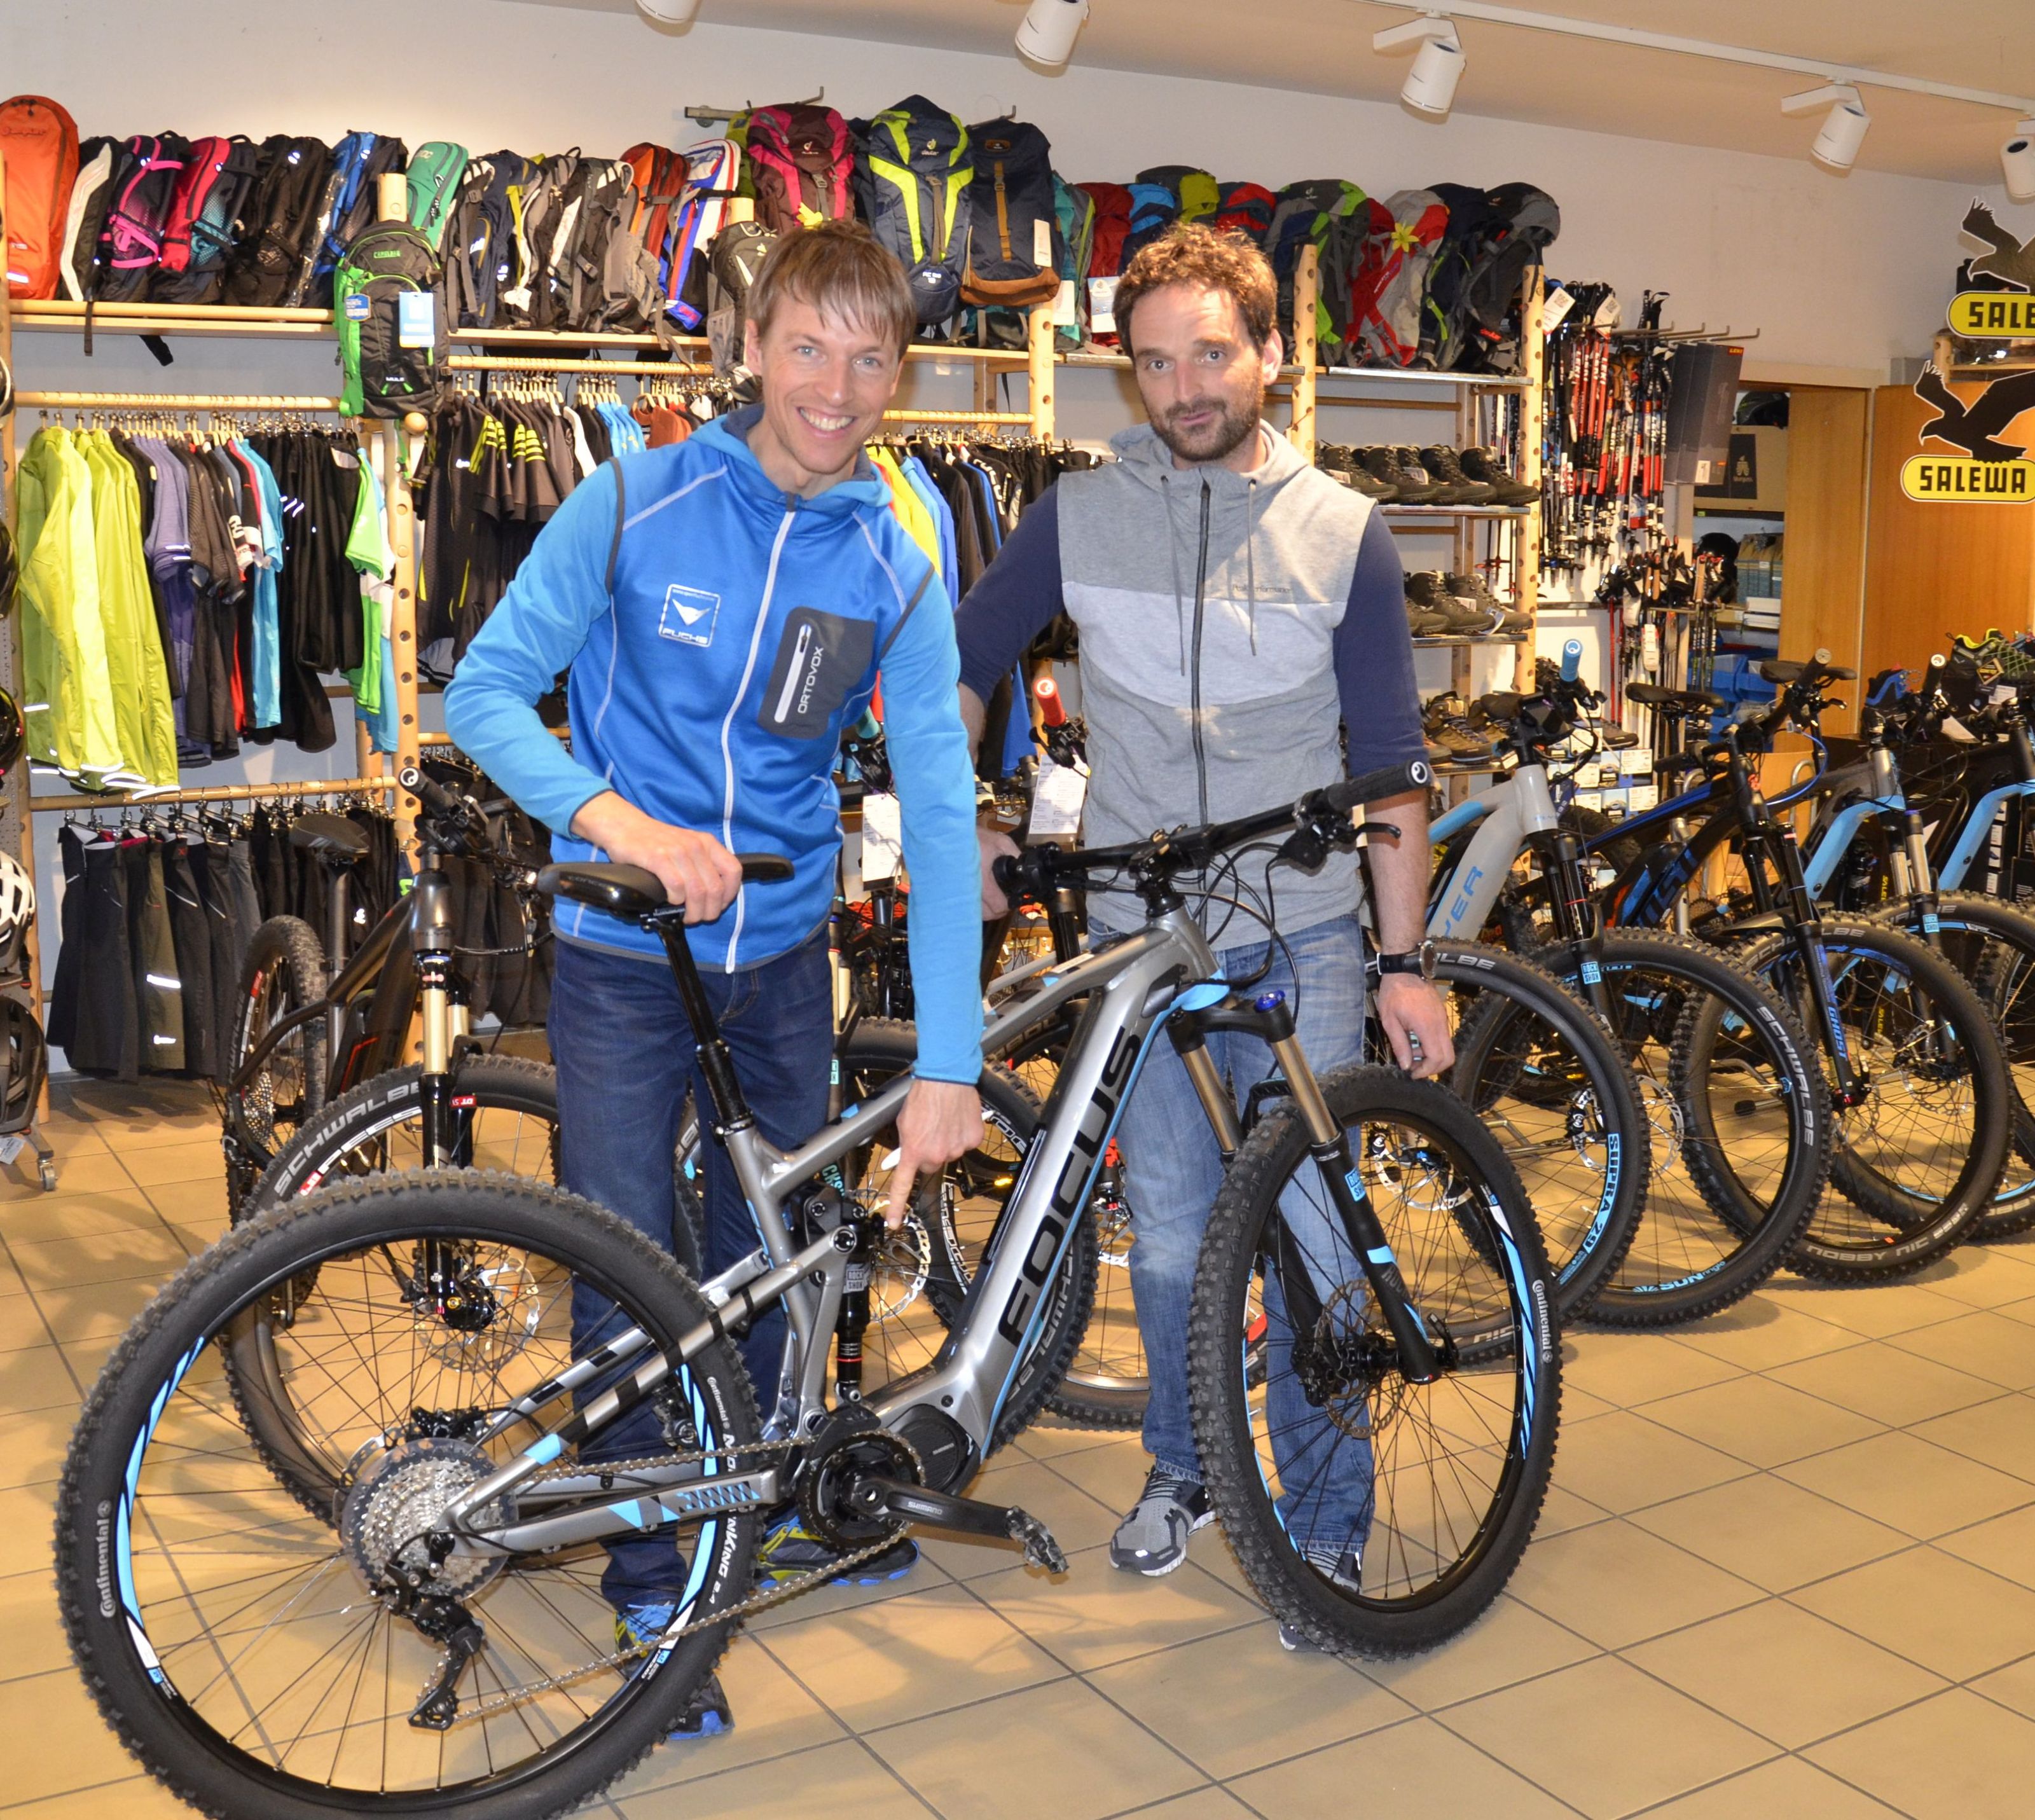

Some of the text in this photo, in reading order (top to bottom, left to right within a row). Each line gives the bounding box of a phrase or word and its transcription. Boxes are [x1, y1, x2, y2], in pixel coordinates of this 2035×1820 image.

[1919, 465, 2026, 493] SALEWA
[662, 628, 708, 644] FUCHS
[797, 646, 824, 714] ORTOVOX
[1828, 1006, 1847, 1058] GHOST
[1756, 1005, 1814, 1147] SCHWALBE
[998, 1026, 1142, 1352] FOCUS
[1596, 1136, 1618, 1213] SUPRA
[1805, 1235, 1930, 1263] NOBBY NIC
[847, 1271, 864, 1281] ROCK
[847, 1281, 864, 1290] SHOX
[1531, 1278, 1553, 1351] Continental
[707, 1375, 729, 1422] Continental
[907, 1500, 943, 1516] SHIMANO
[96, 1518, 116, 1618] Continental
